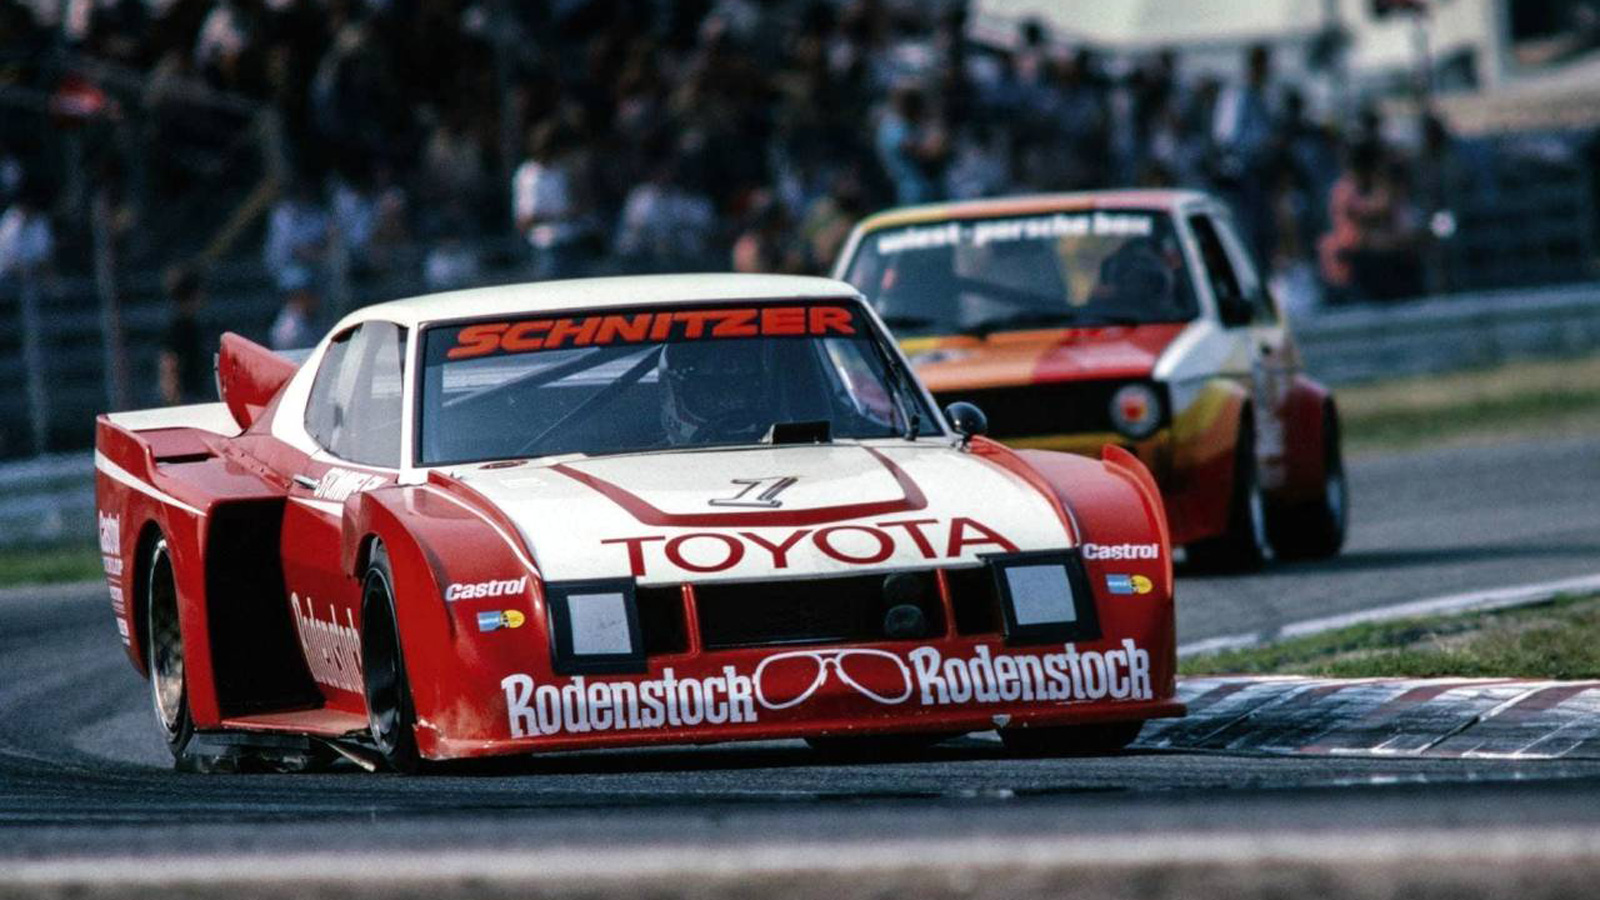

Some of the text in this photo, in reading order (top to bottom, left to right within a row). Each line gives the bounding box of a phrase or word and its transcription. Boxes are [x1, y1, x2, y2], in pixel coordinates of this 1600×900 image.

[447, 306, 856, 359] SCHNITZER
[708, 476, 799, 508] 1
[601, 517, 1020, 577] TOYOTA
[1083, 543, 1159, 560] Castrol
[445, 574, 528, 602] Castrol
[908, 638, 1153, 705] Rodenstock
[501, 665, 758, 739] Rodenstock
